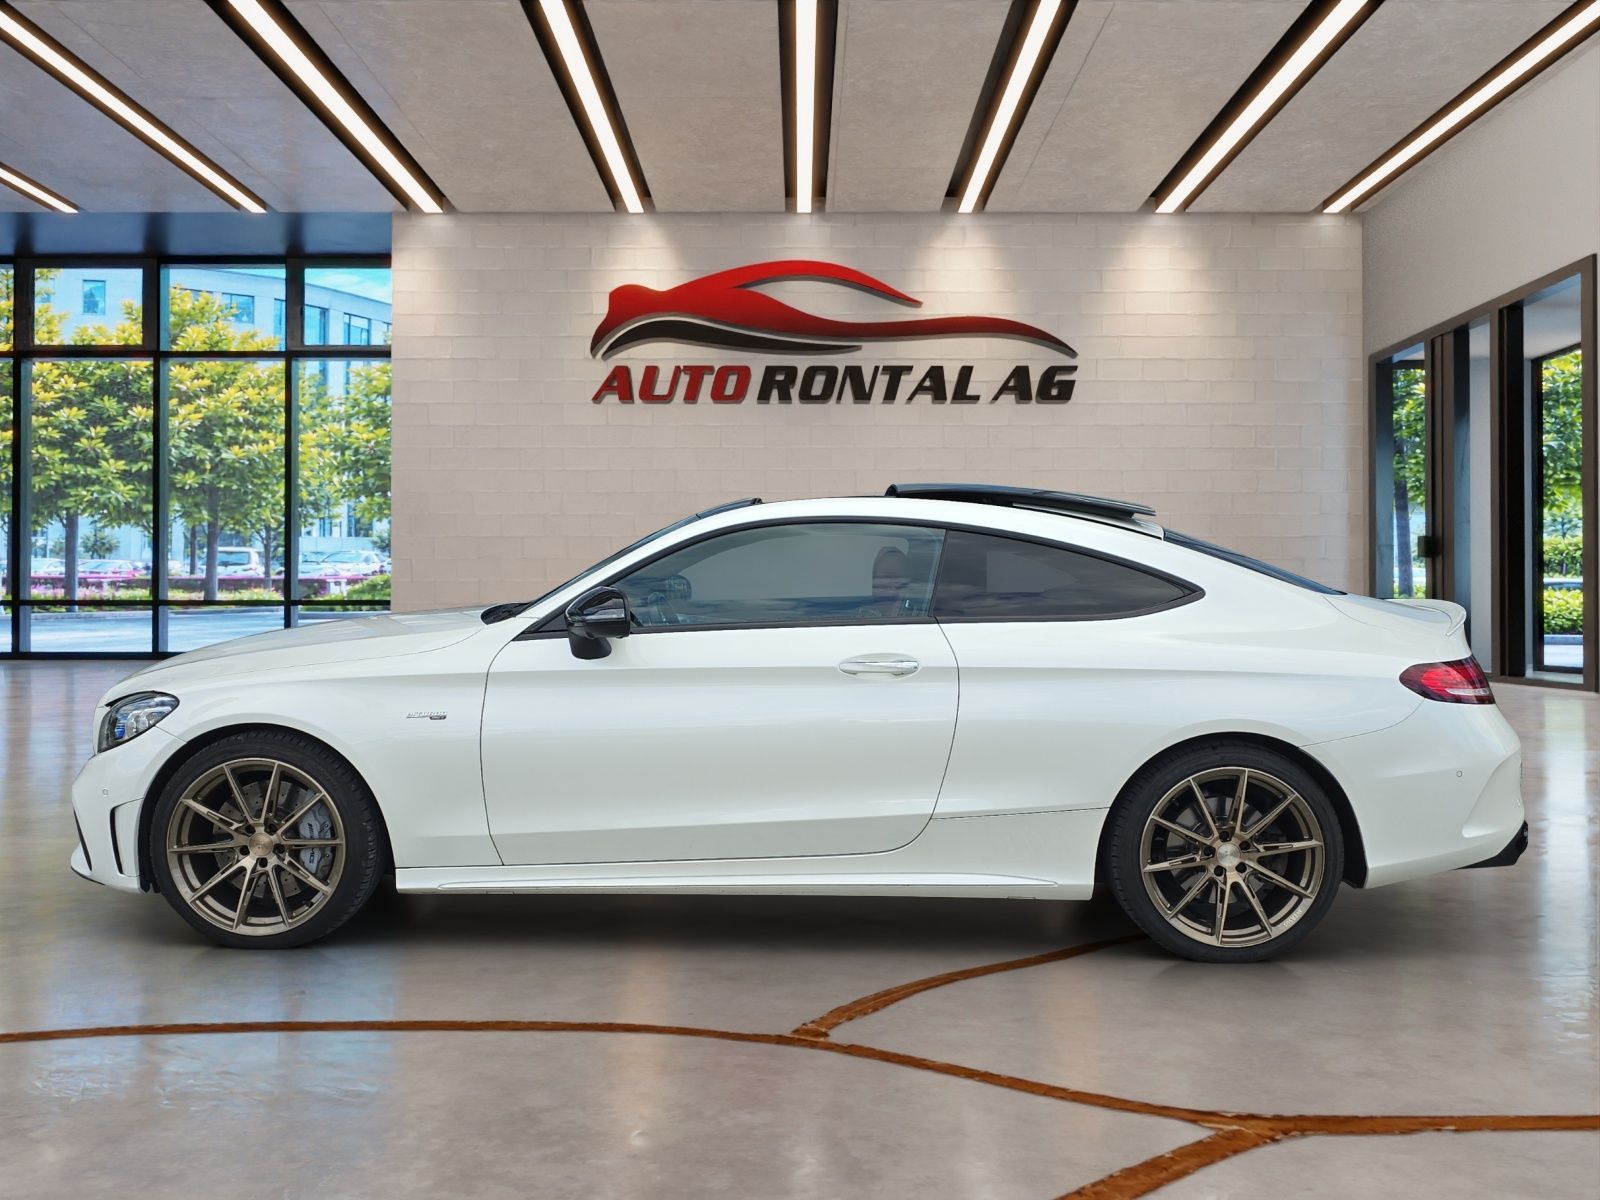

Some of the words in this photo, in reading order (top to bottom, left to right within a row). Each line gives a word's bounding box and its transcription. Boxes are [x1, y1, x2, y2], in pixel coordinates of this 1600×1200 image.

[591, 365, 752, 404] AUTO
[756, 365, 980, 404] RONTAL
[988, 365, 1078, 404] AG
